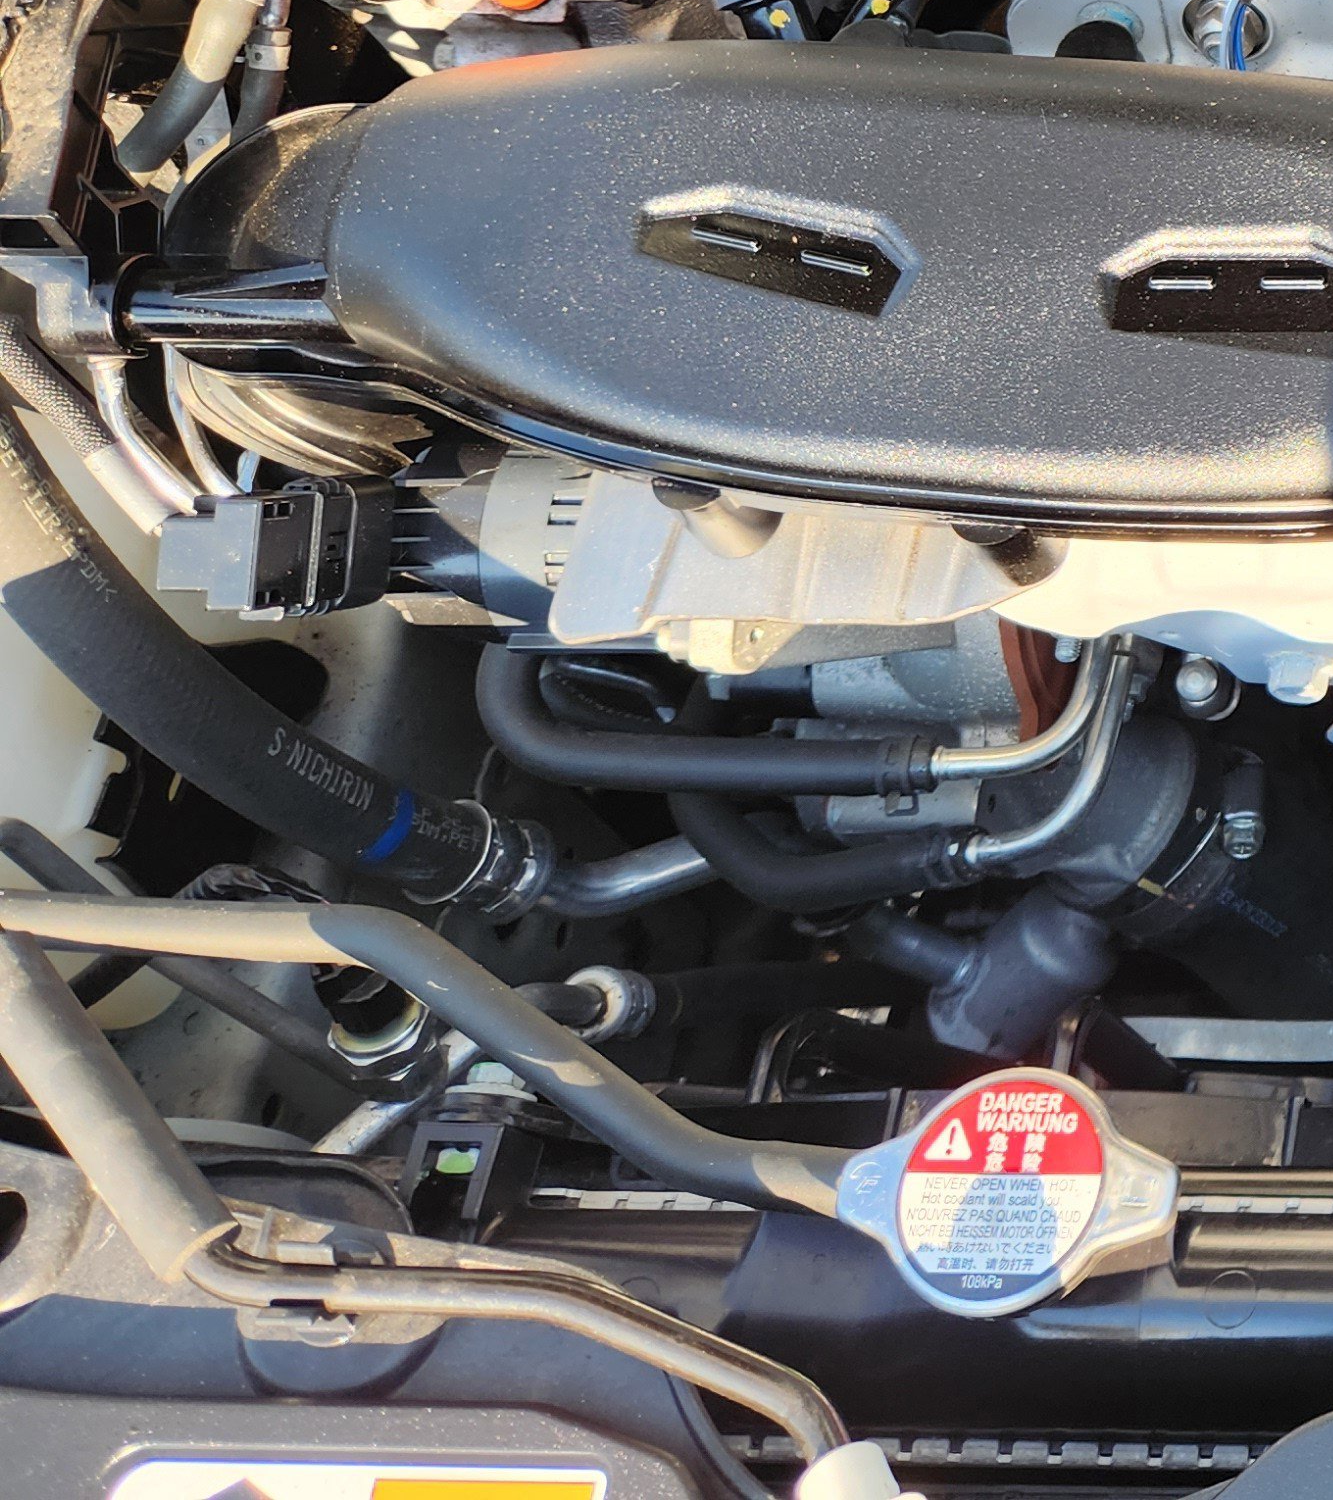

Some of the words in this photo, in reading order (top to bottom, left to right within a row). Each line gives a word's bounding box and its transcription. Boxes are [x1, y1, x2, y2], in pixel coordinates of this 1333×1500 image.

[979, 1091, 1064, 1113] DANGER
[976, 1111, 1079, 1134] WARNUNG
[924, 1176, 969, 1190] NEVER
[971, 1177, 1007, 1191] OPEN
[921, 1192, 942, 1205] Hot
[943, 1193, 985, 1206] coolant
[987, 1193, 1006, 1206] will
[1008, 1194, 1037, 1206] scald
[906, 1208, 968, 1222] N'OUVREZ
[969, 1209, 994, 1223] PAS
[996, 1209, 1038, 1223] QUAND
[1040, 1209, 1082, 1223] CHAUD
[908, 1224, 938, 1238] NICHT
[938, 1224, 956, 1238] BEI
[956, 1225, 999, 1239] HEISSEM
[999, 1225, 1035, 1239] MOTOR
[961, 1274, 1003, 1289] 108kPa
